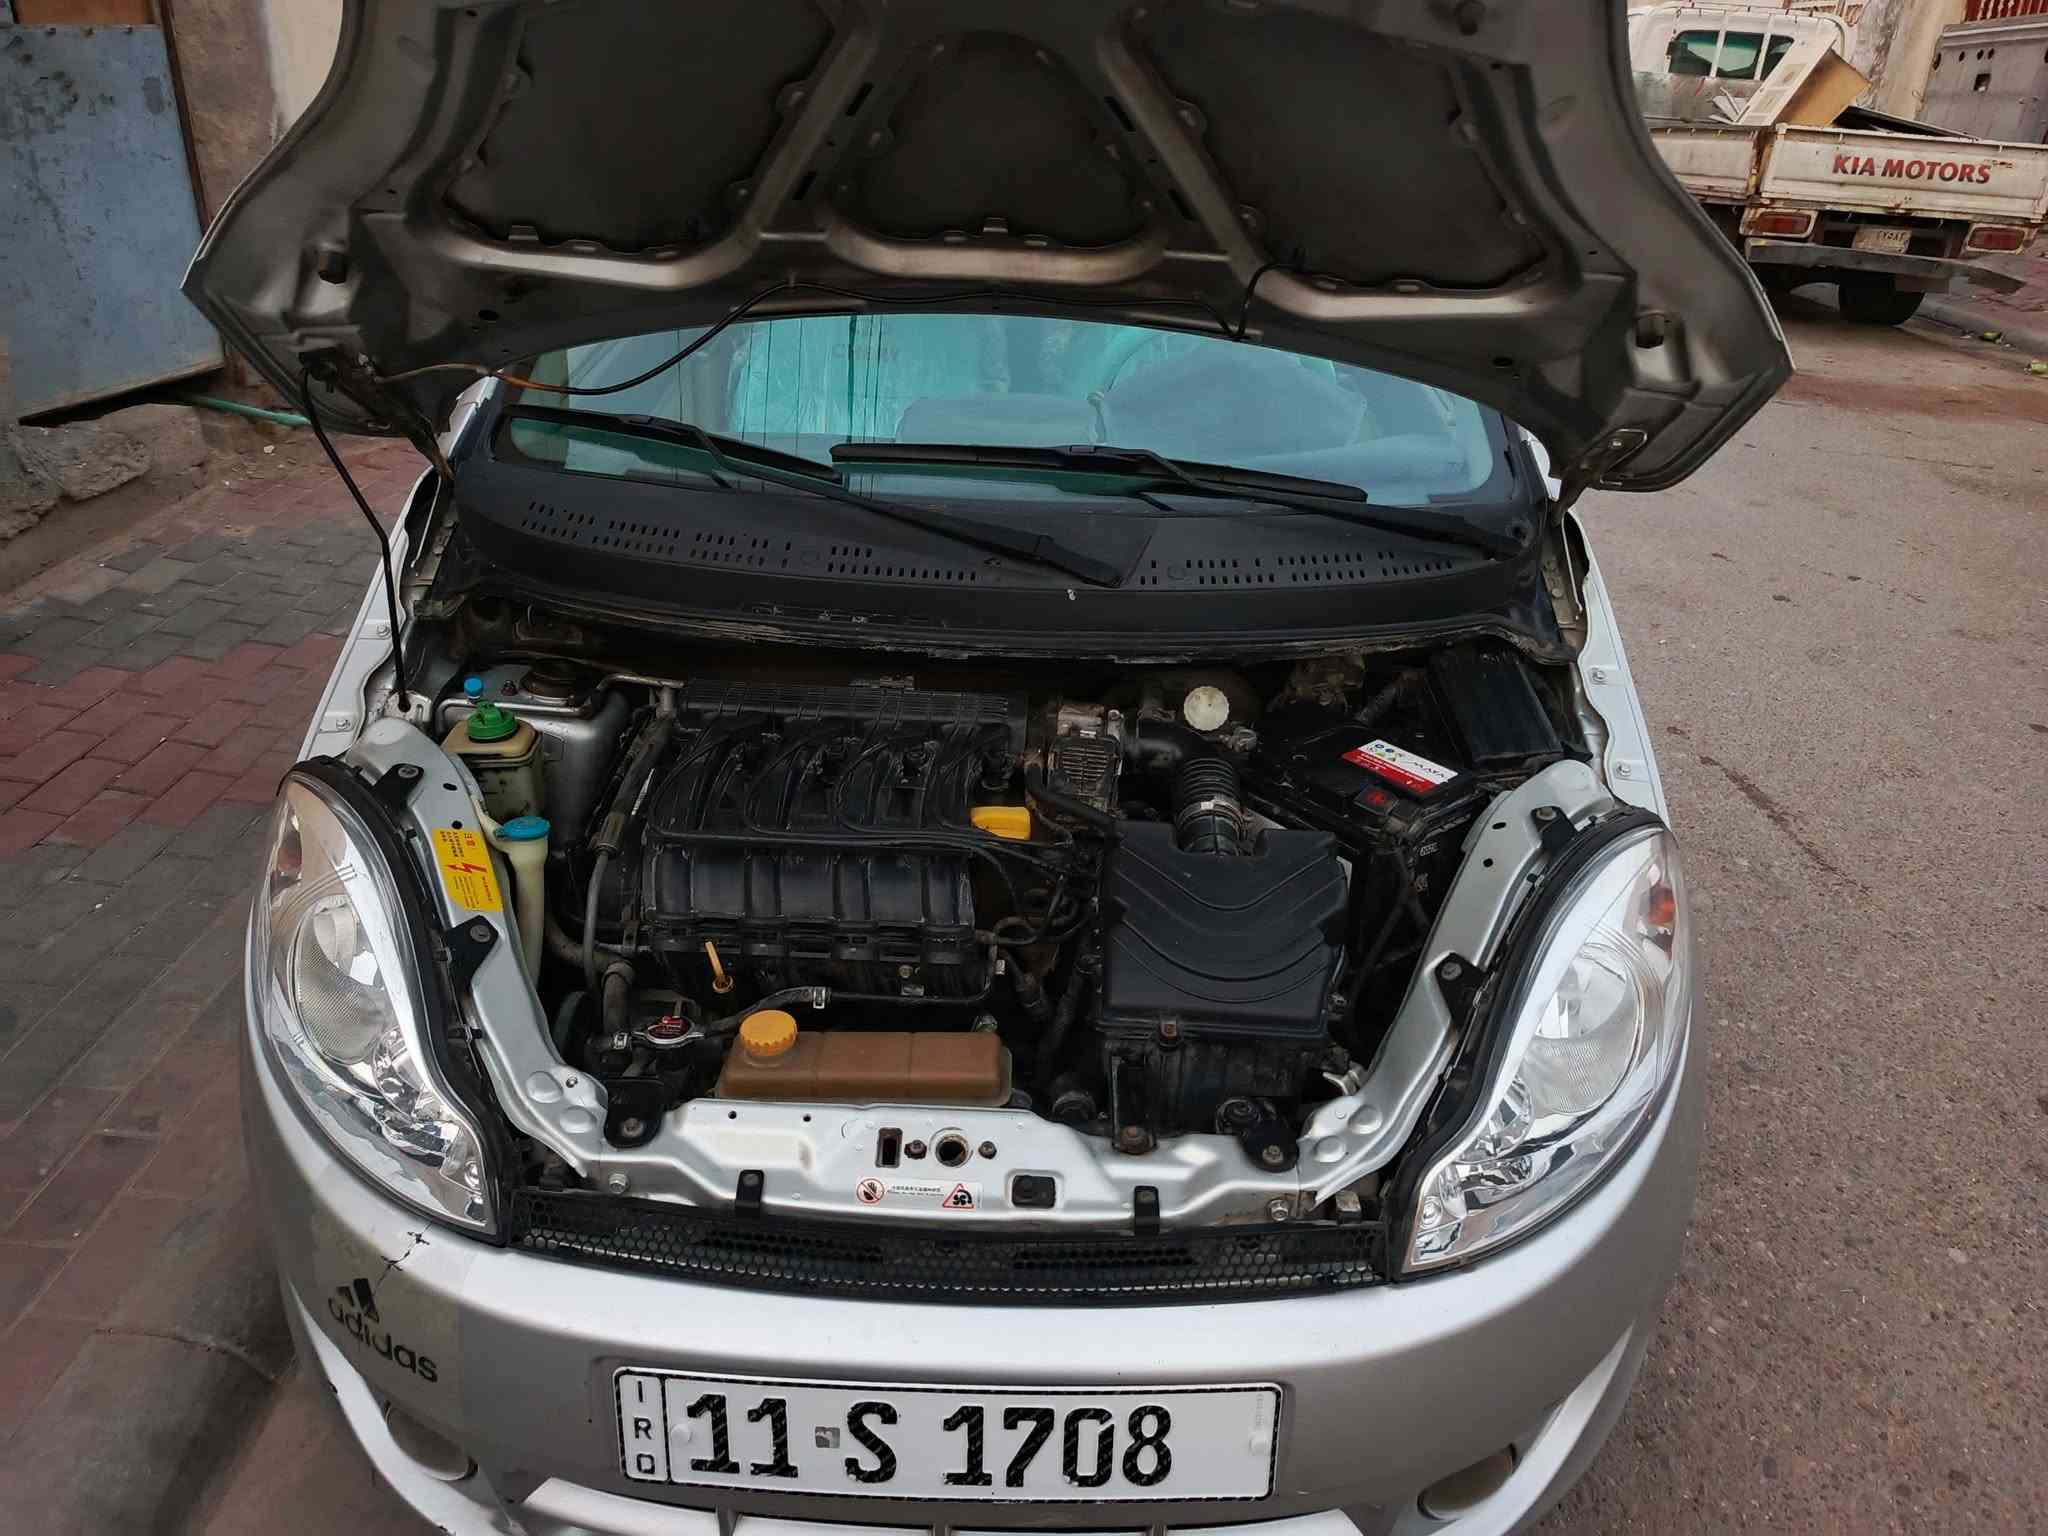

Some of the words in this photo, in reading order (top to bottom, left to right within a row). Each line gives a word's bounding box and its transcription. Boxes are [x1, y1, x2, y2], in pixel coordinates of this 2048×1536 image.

[1832, 154, 1875, 177] KIA
[1881, 158, 1991, 184] MOTORS
[686, 1393, 799, 1479] 11
[844, 1401, 898, 1484] S
[943, 1404, 1173, 1488] 1708
